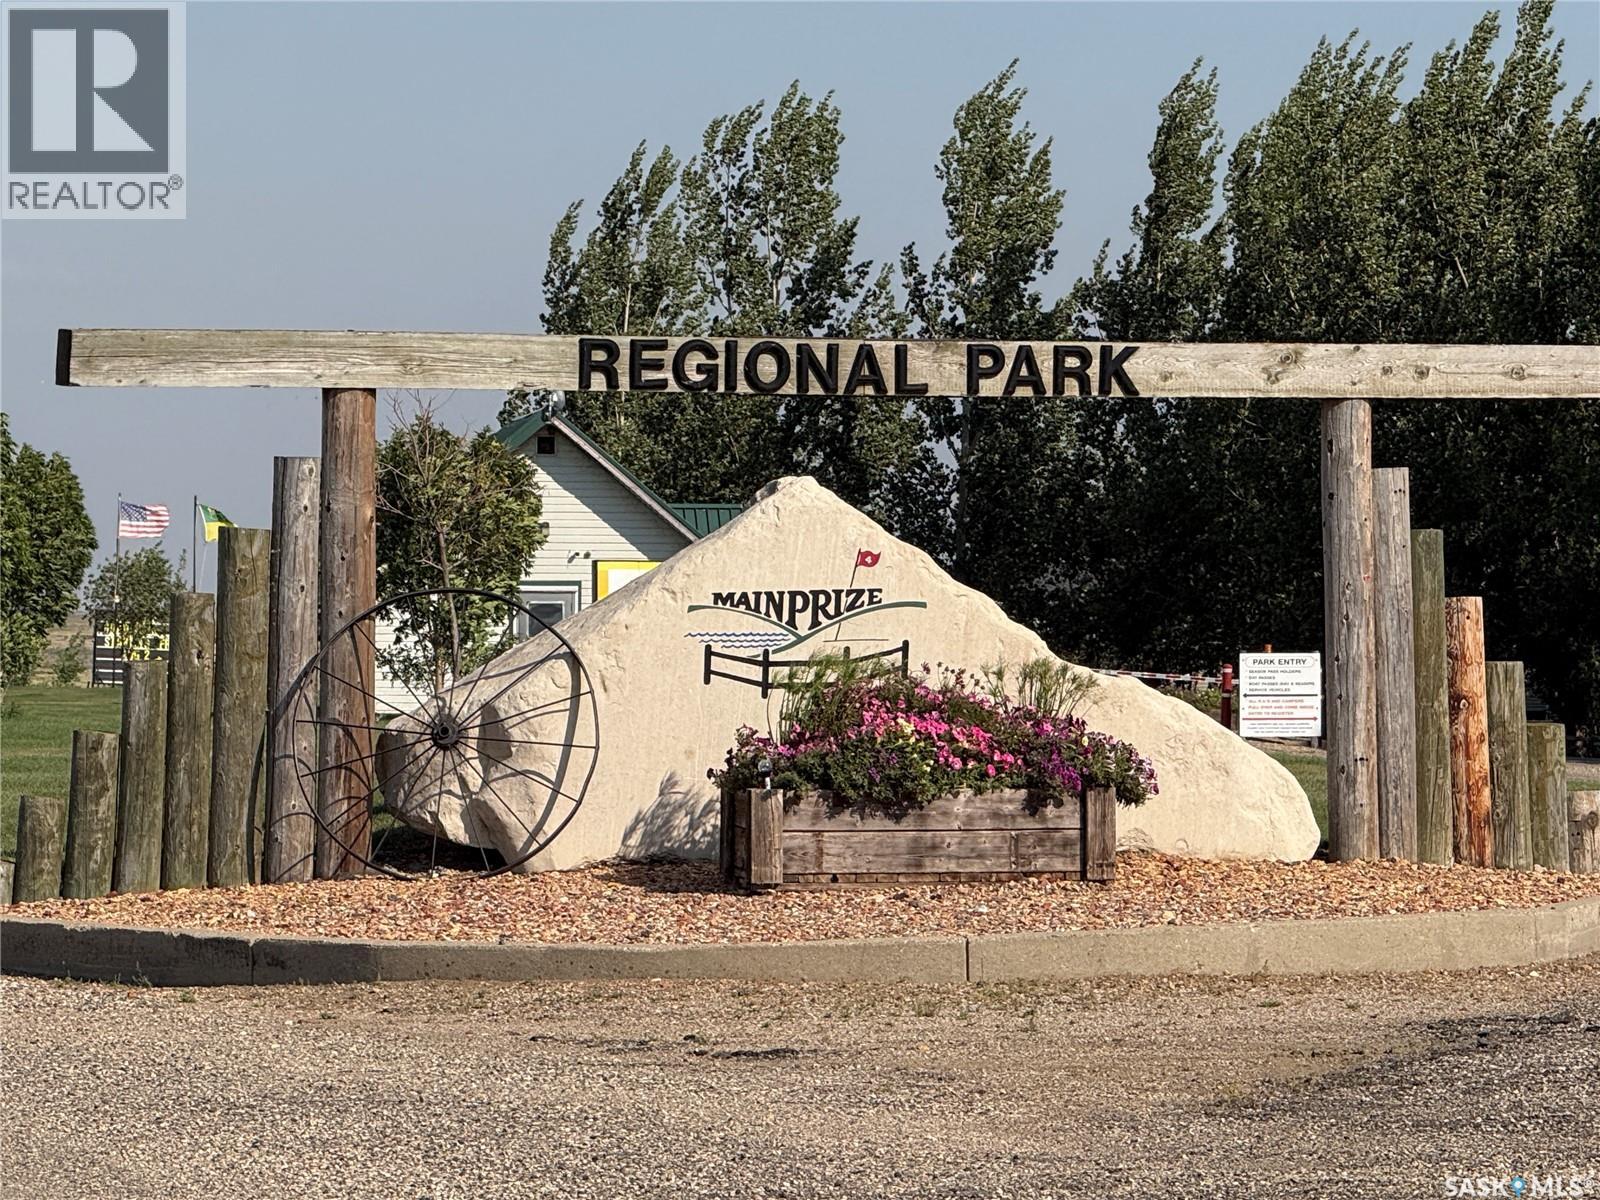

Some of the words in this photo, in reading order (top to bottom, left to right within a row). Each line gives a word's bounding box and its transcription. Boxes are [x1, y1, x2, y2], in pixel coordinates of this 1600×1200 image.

[577, 337, 929, 396] REGIONAL
[965, 343, 1140, 397] PARK
[712, 588, 883, 630] MAINPRIZE
[1252, 658, 1276, 666] PARK
[1278, 658, 1307, 666] ENTRY
